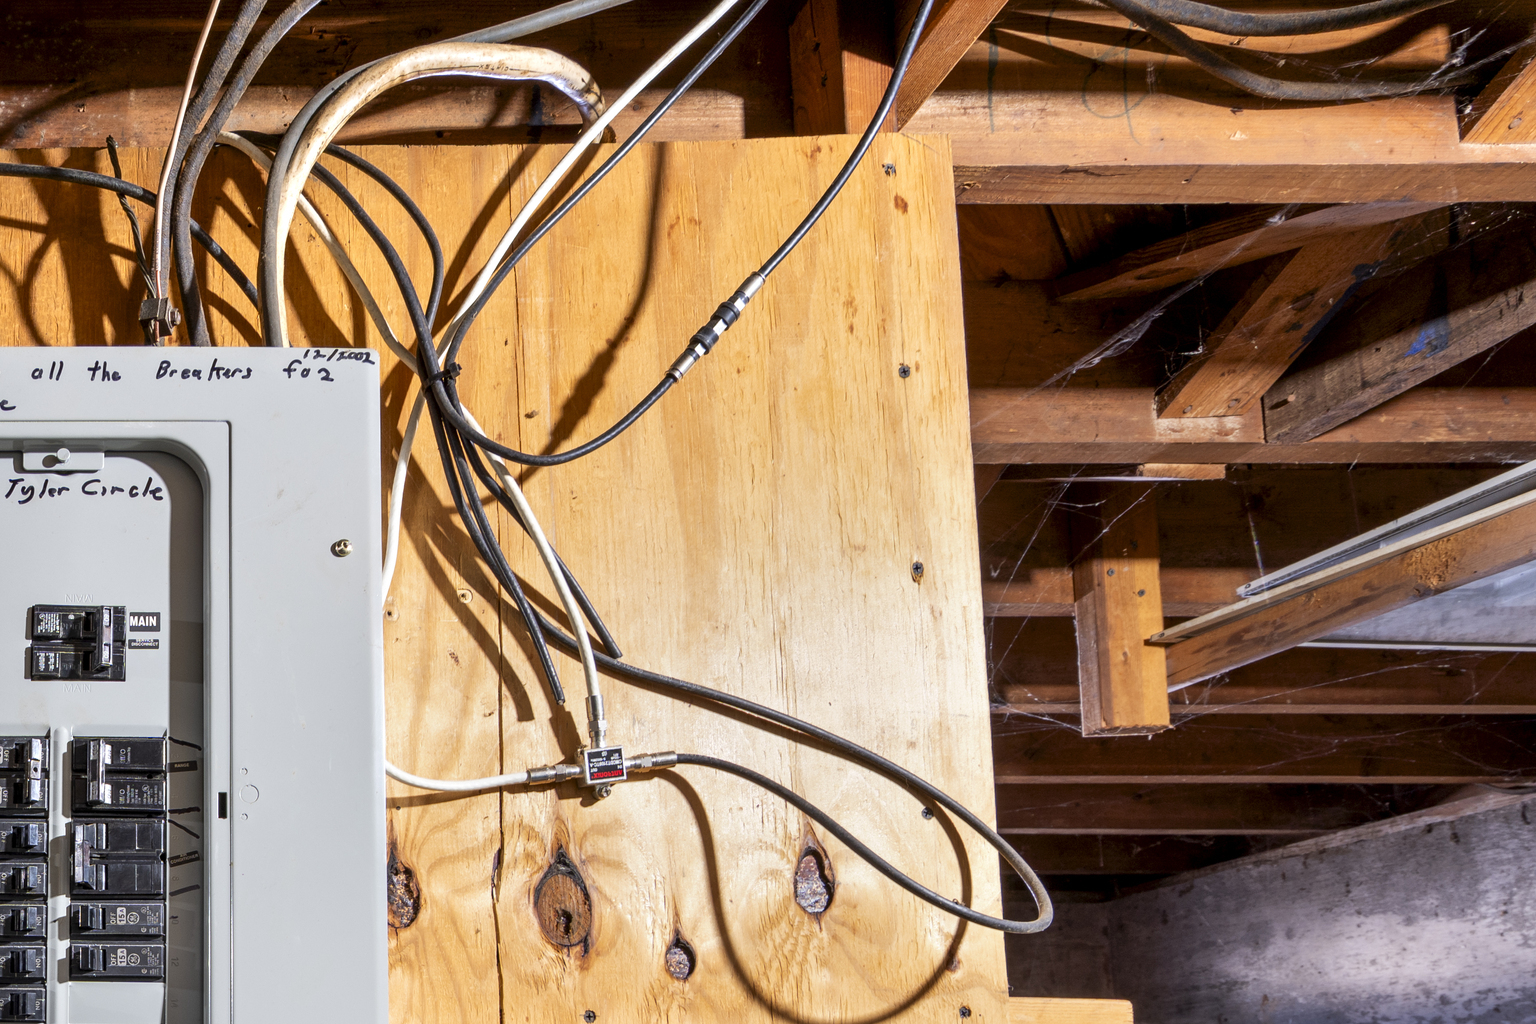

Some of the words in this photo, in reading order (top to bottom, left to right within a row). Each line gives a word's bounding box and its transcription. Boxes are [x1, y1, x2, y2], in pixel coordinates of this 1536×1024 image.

[31, 361, 64, 381] all
[87, 361, 121, 381] the
[156, 359, 252, 381] Breakers
[5, 478, 69, 504] Tyler
[82, 477, 163, 501] Circle
[130, 616, 157, 627] MAIN
